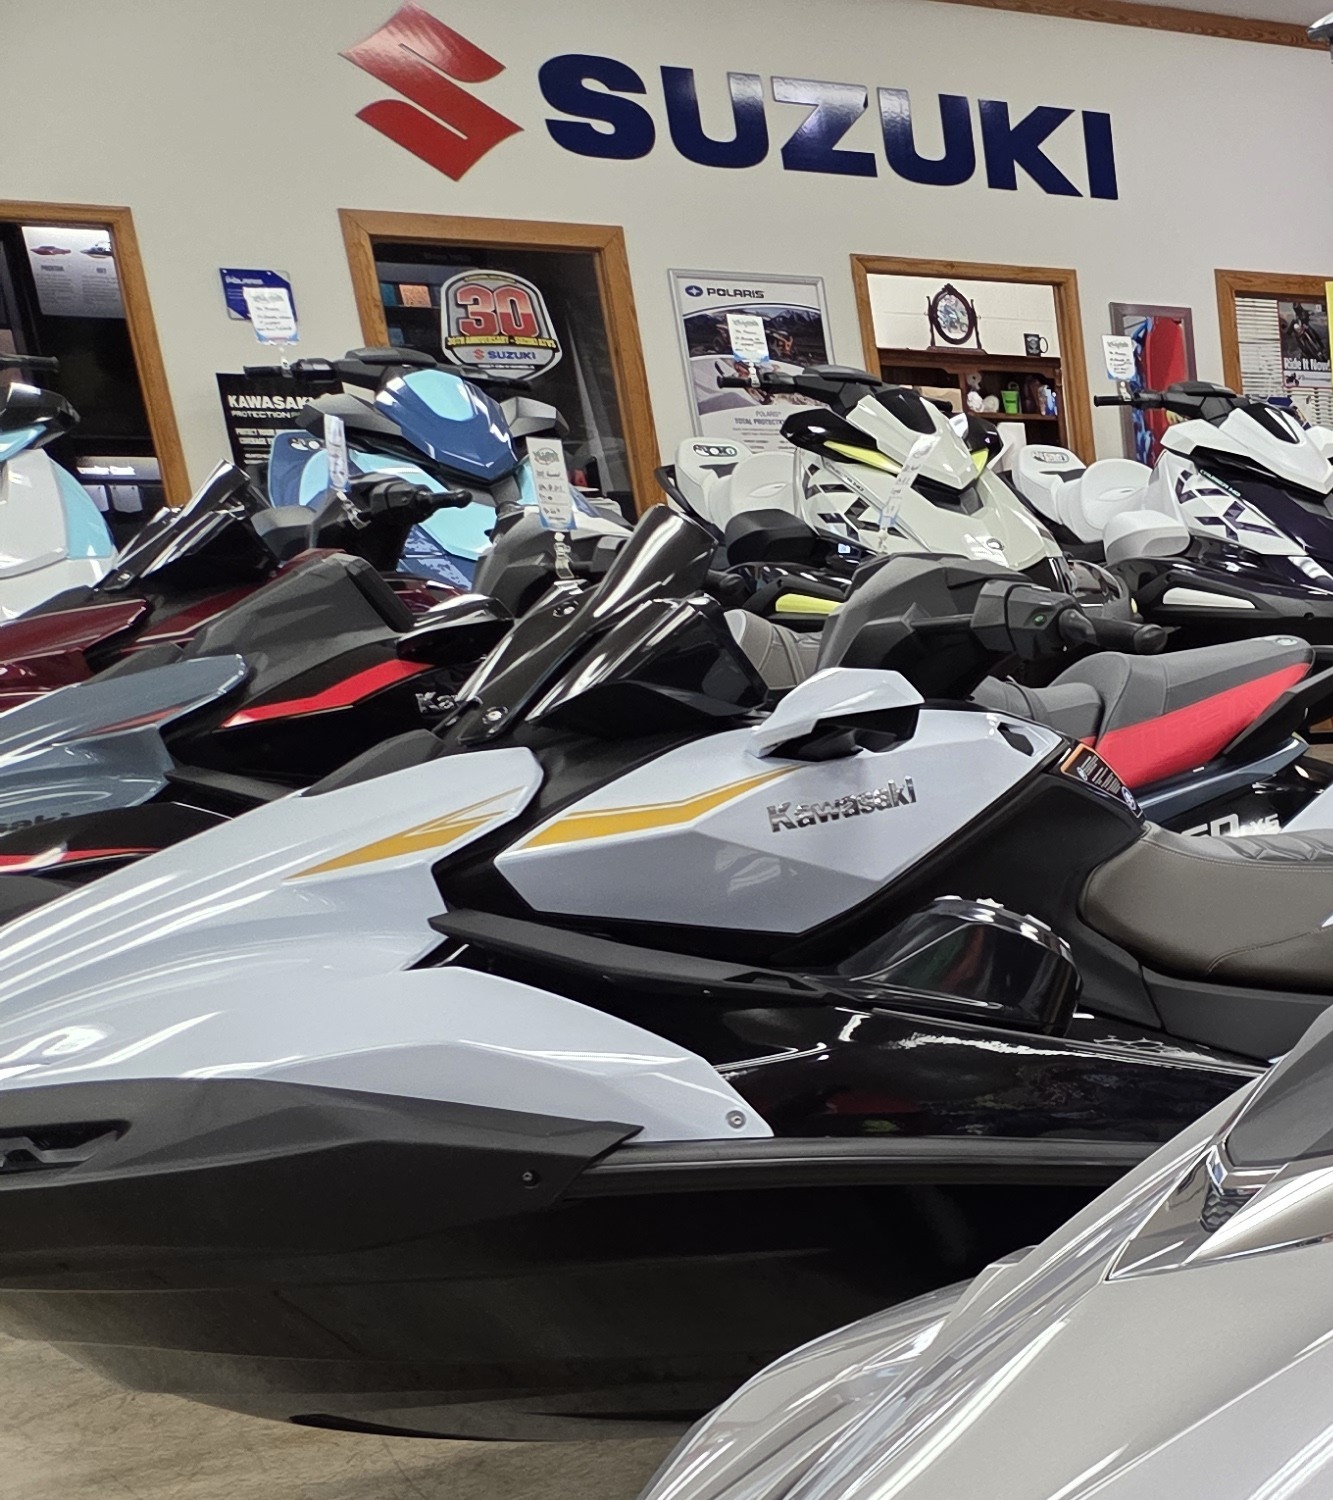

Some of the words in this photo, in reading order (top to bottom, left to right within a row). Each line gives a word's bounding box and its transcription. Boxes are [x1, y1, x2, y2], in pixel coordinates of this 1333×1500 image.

[538, 53, 1118, 200] SUZUKI
[707, 287, 765, 299] POLARIS
[457, 285, 539, 337] 30
[488, 350, 536, 360] SUZUKI
[228, 395, 314, 409] KAWASAK
[767, 775, 917, 833] Kawasaki
